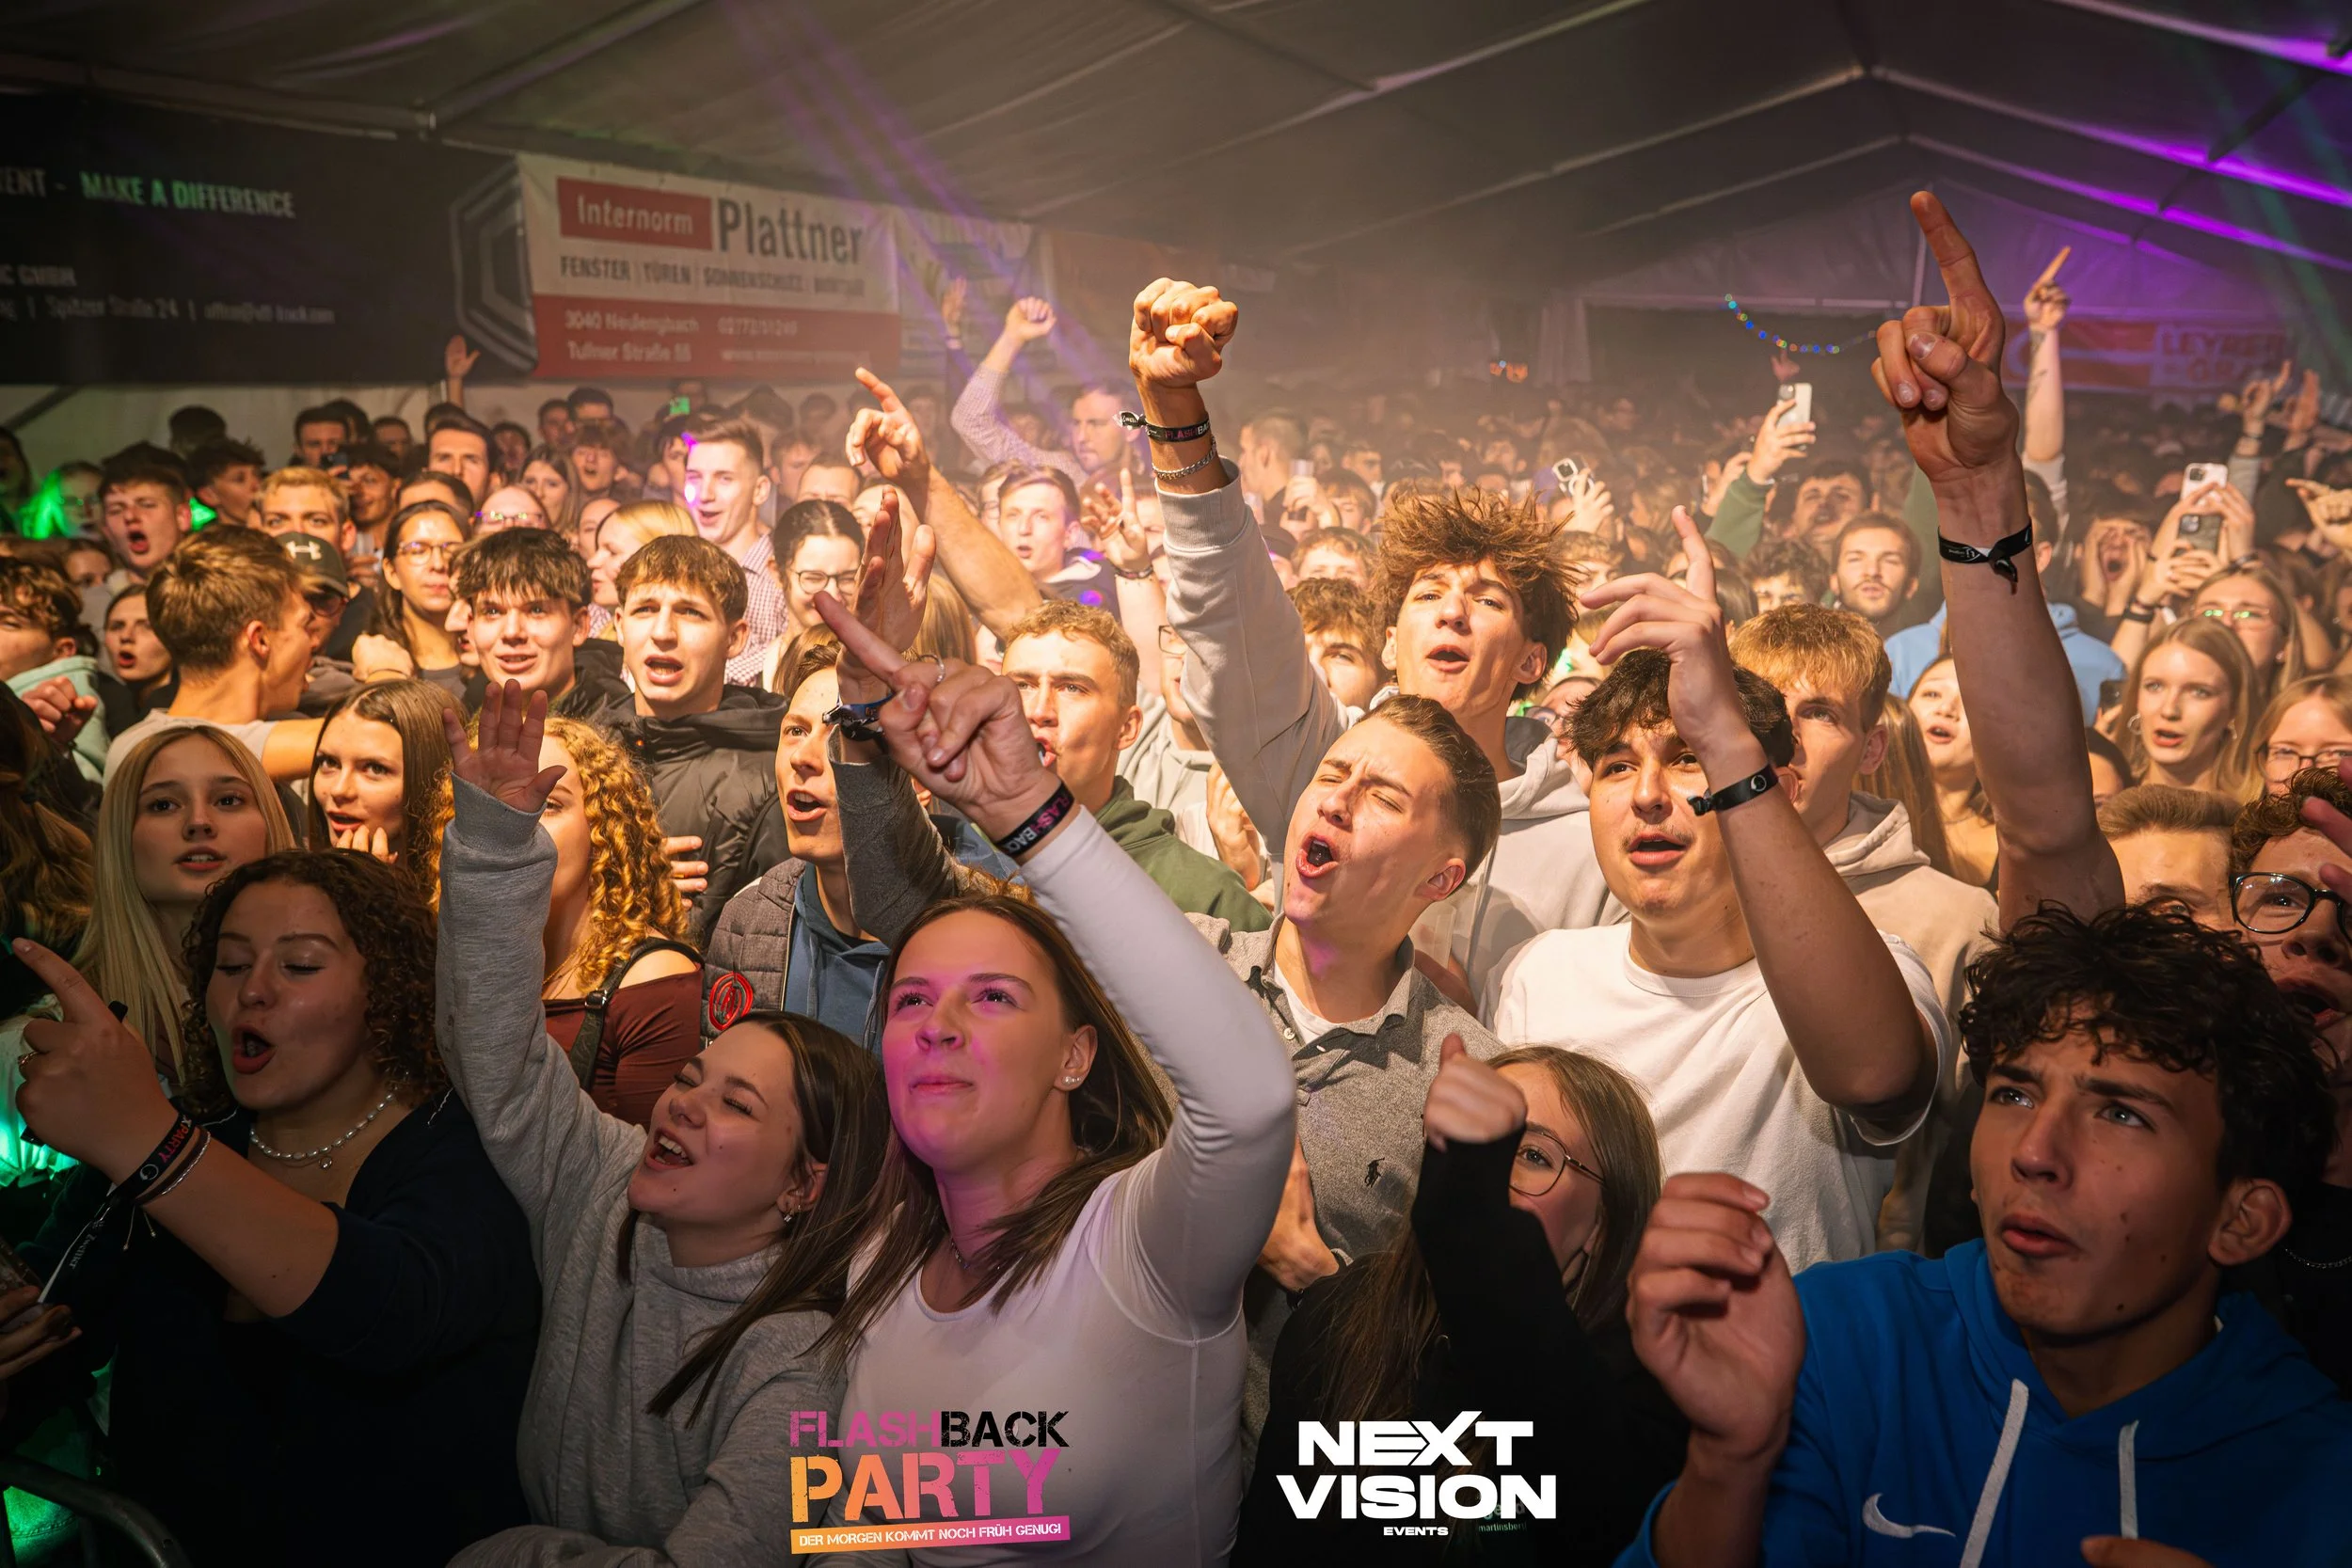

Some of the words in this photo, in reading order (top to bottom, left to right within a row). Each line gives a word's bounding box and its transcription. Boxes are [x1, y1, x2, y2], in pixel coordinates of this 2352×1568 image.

[79, 171, 146, 206] MAKE
[151, 179, 168, 208] A
[170, 180, 297, 219] DIFFERENCE
[577, 194, 694, 236] Internorm
[717, 198, 865, 265] Plattner
[560, 255, 630, 280] FENSTER
[157, 1124, 190, 1164] PARTY
